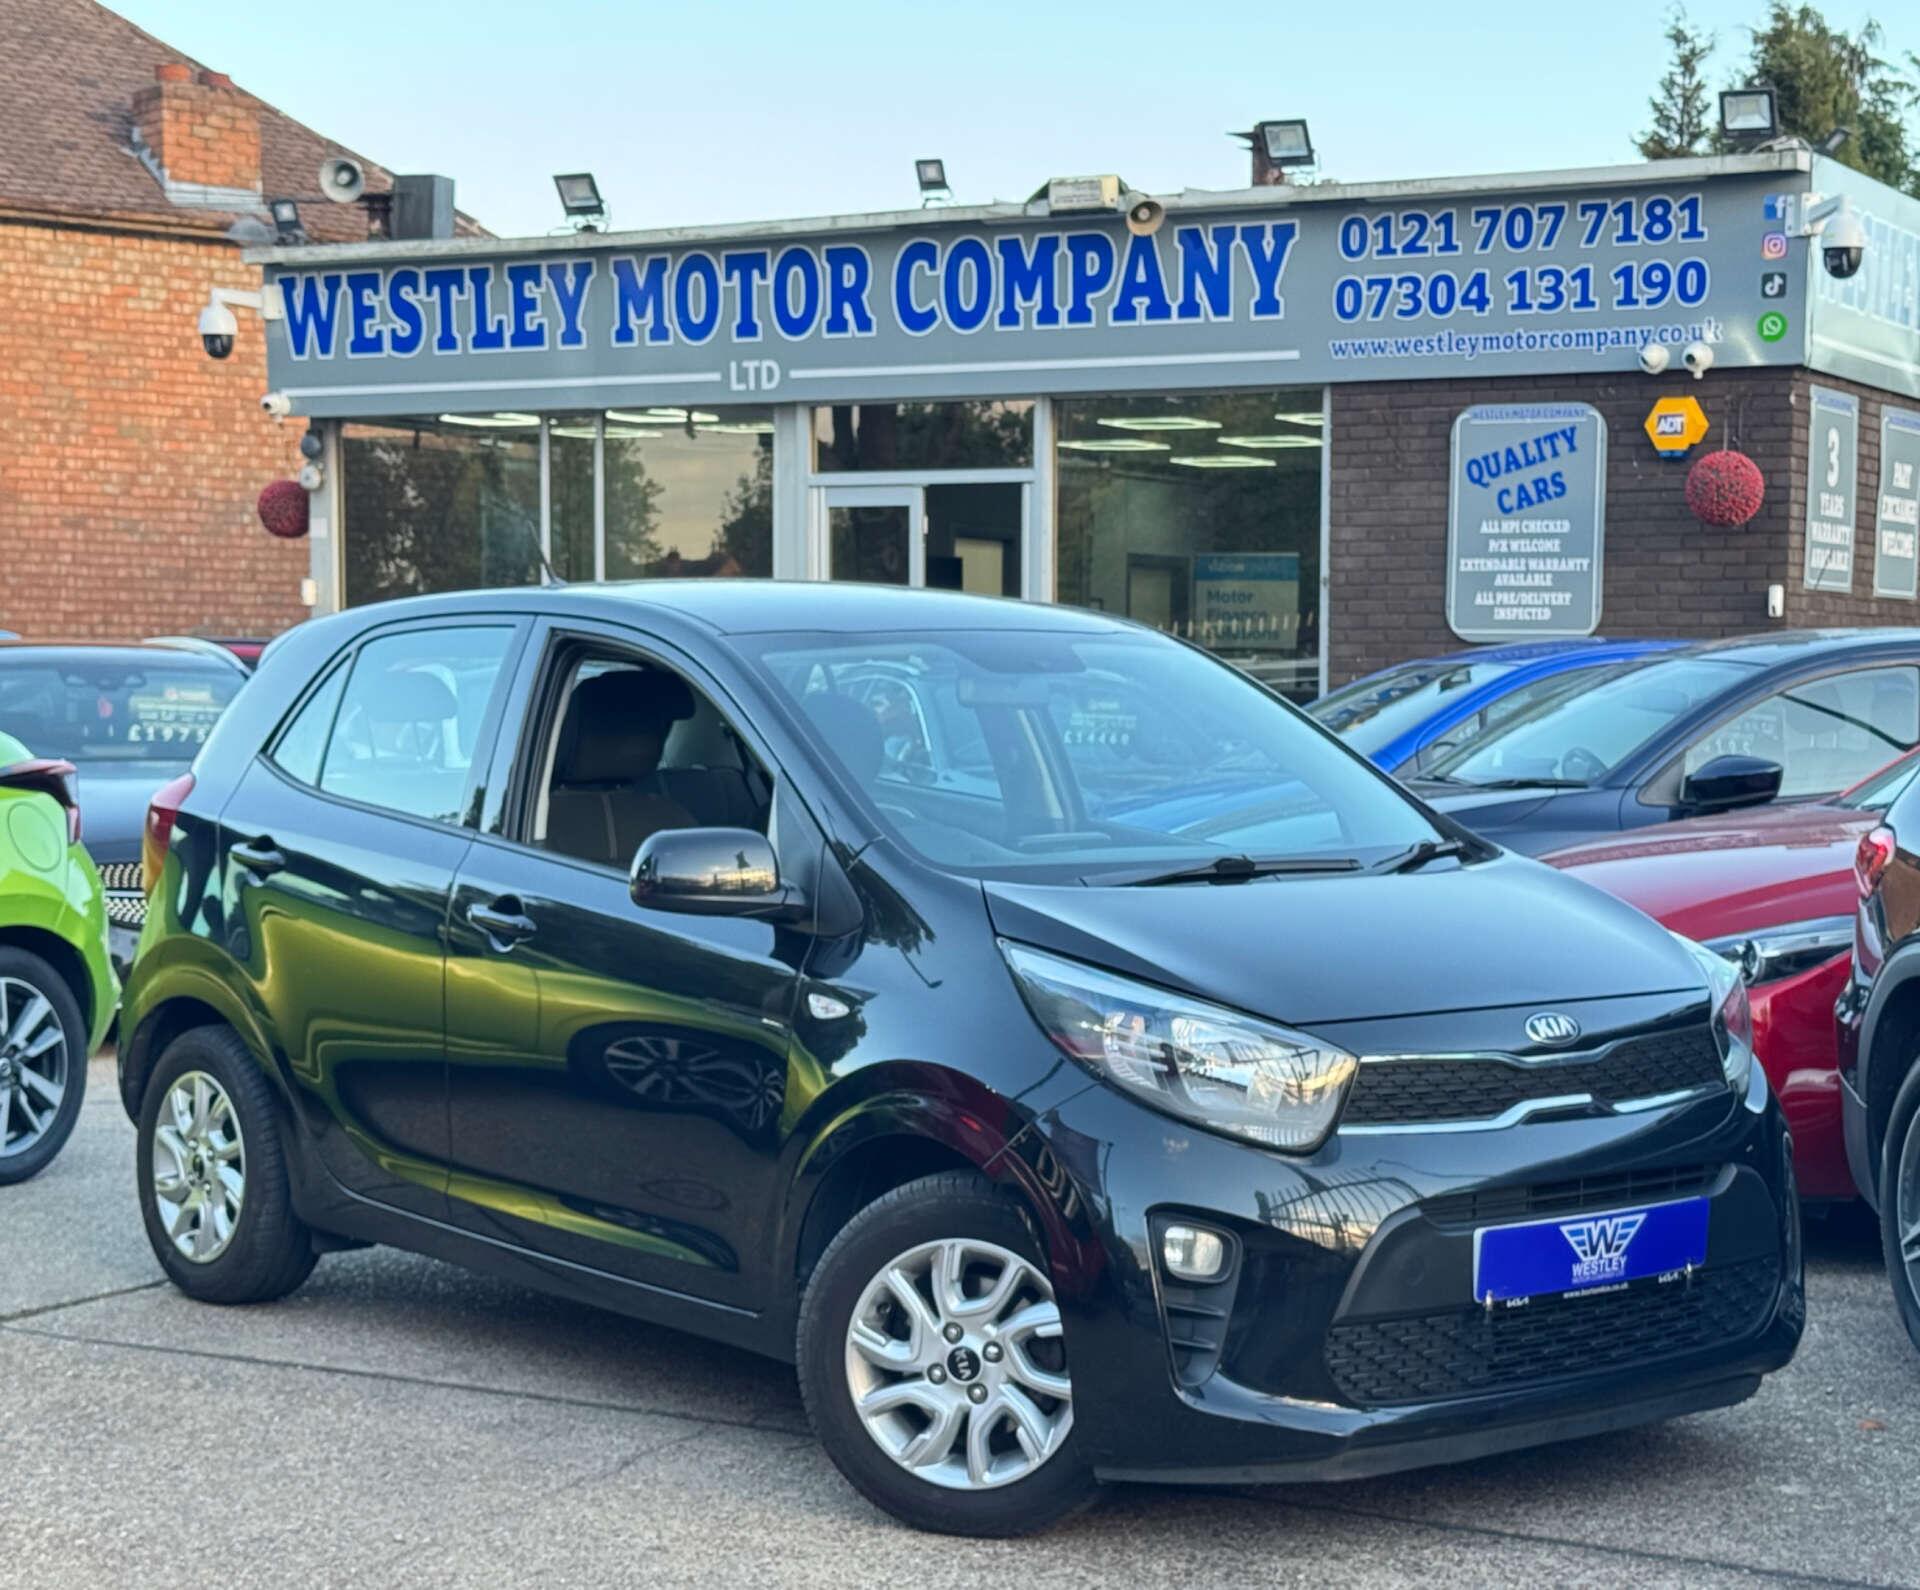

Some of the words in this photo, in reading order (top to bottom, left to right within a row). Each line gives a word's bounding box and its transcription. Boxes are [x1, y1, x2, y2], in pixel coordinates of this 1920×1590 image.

[1338, 209, 1462, 261] 0121
[1471, 202, 1571, 254] 707
[1577, 194, 1706, 249] 7181
[275, 259, 596, 362] WESTLEY
[610, 244, 877, 348] MOTOR
[892, 219, 1300, 337] COMPANY
[1333, 270, 1493, 324] 07304
[1504, 265, 1598, 315] 131
[1610, 258, 1709, 310] 190
[1330, 317, 1723, 361] www.westleymotorcompany.co.uk
[729, 360, 781, 392] LTD
[1657, 416, 1685, 434] ADT
[1466, 426, 1578, 488] QUALITY
[1827, 427, 1839, 488] 3
[1497, 471, 1568, 515] CARS
[1521, 518, 1571, 534] CHECKED
[1509, 539, 1561, 553] WELCOME
[1459, 558, 1526, 572] EXTENDABLE
[1527, 557, 1590, 572] WARRANTY
[1494, 573, 1553, 587] AVAILABLE
[1206, 589, 1255, 604] Motor
[1494, 607, 1551, 621] INSPECTED
[1531, 1014, 1577, 1040] KIA
[1571, 1254, 1628, 1277] WESTLEY
[954, 1348, 972, 1379] KIA
